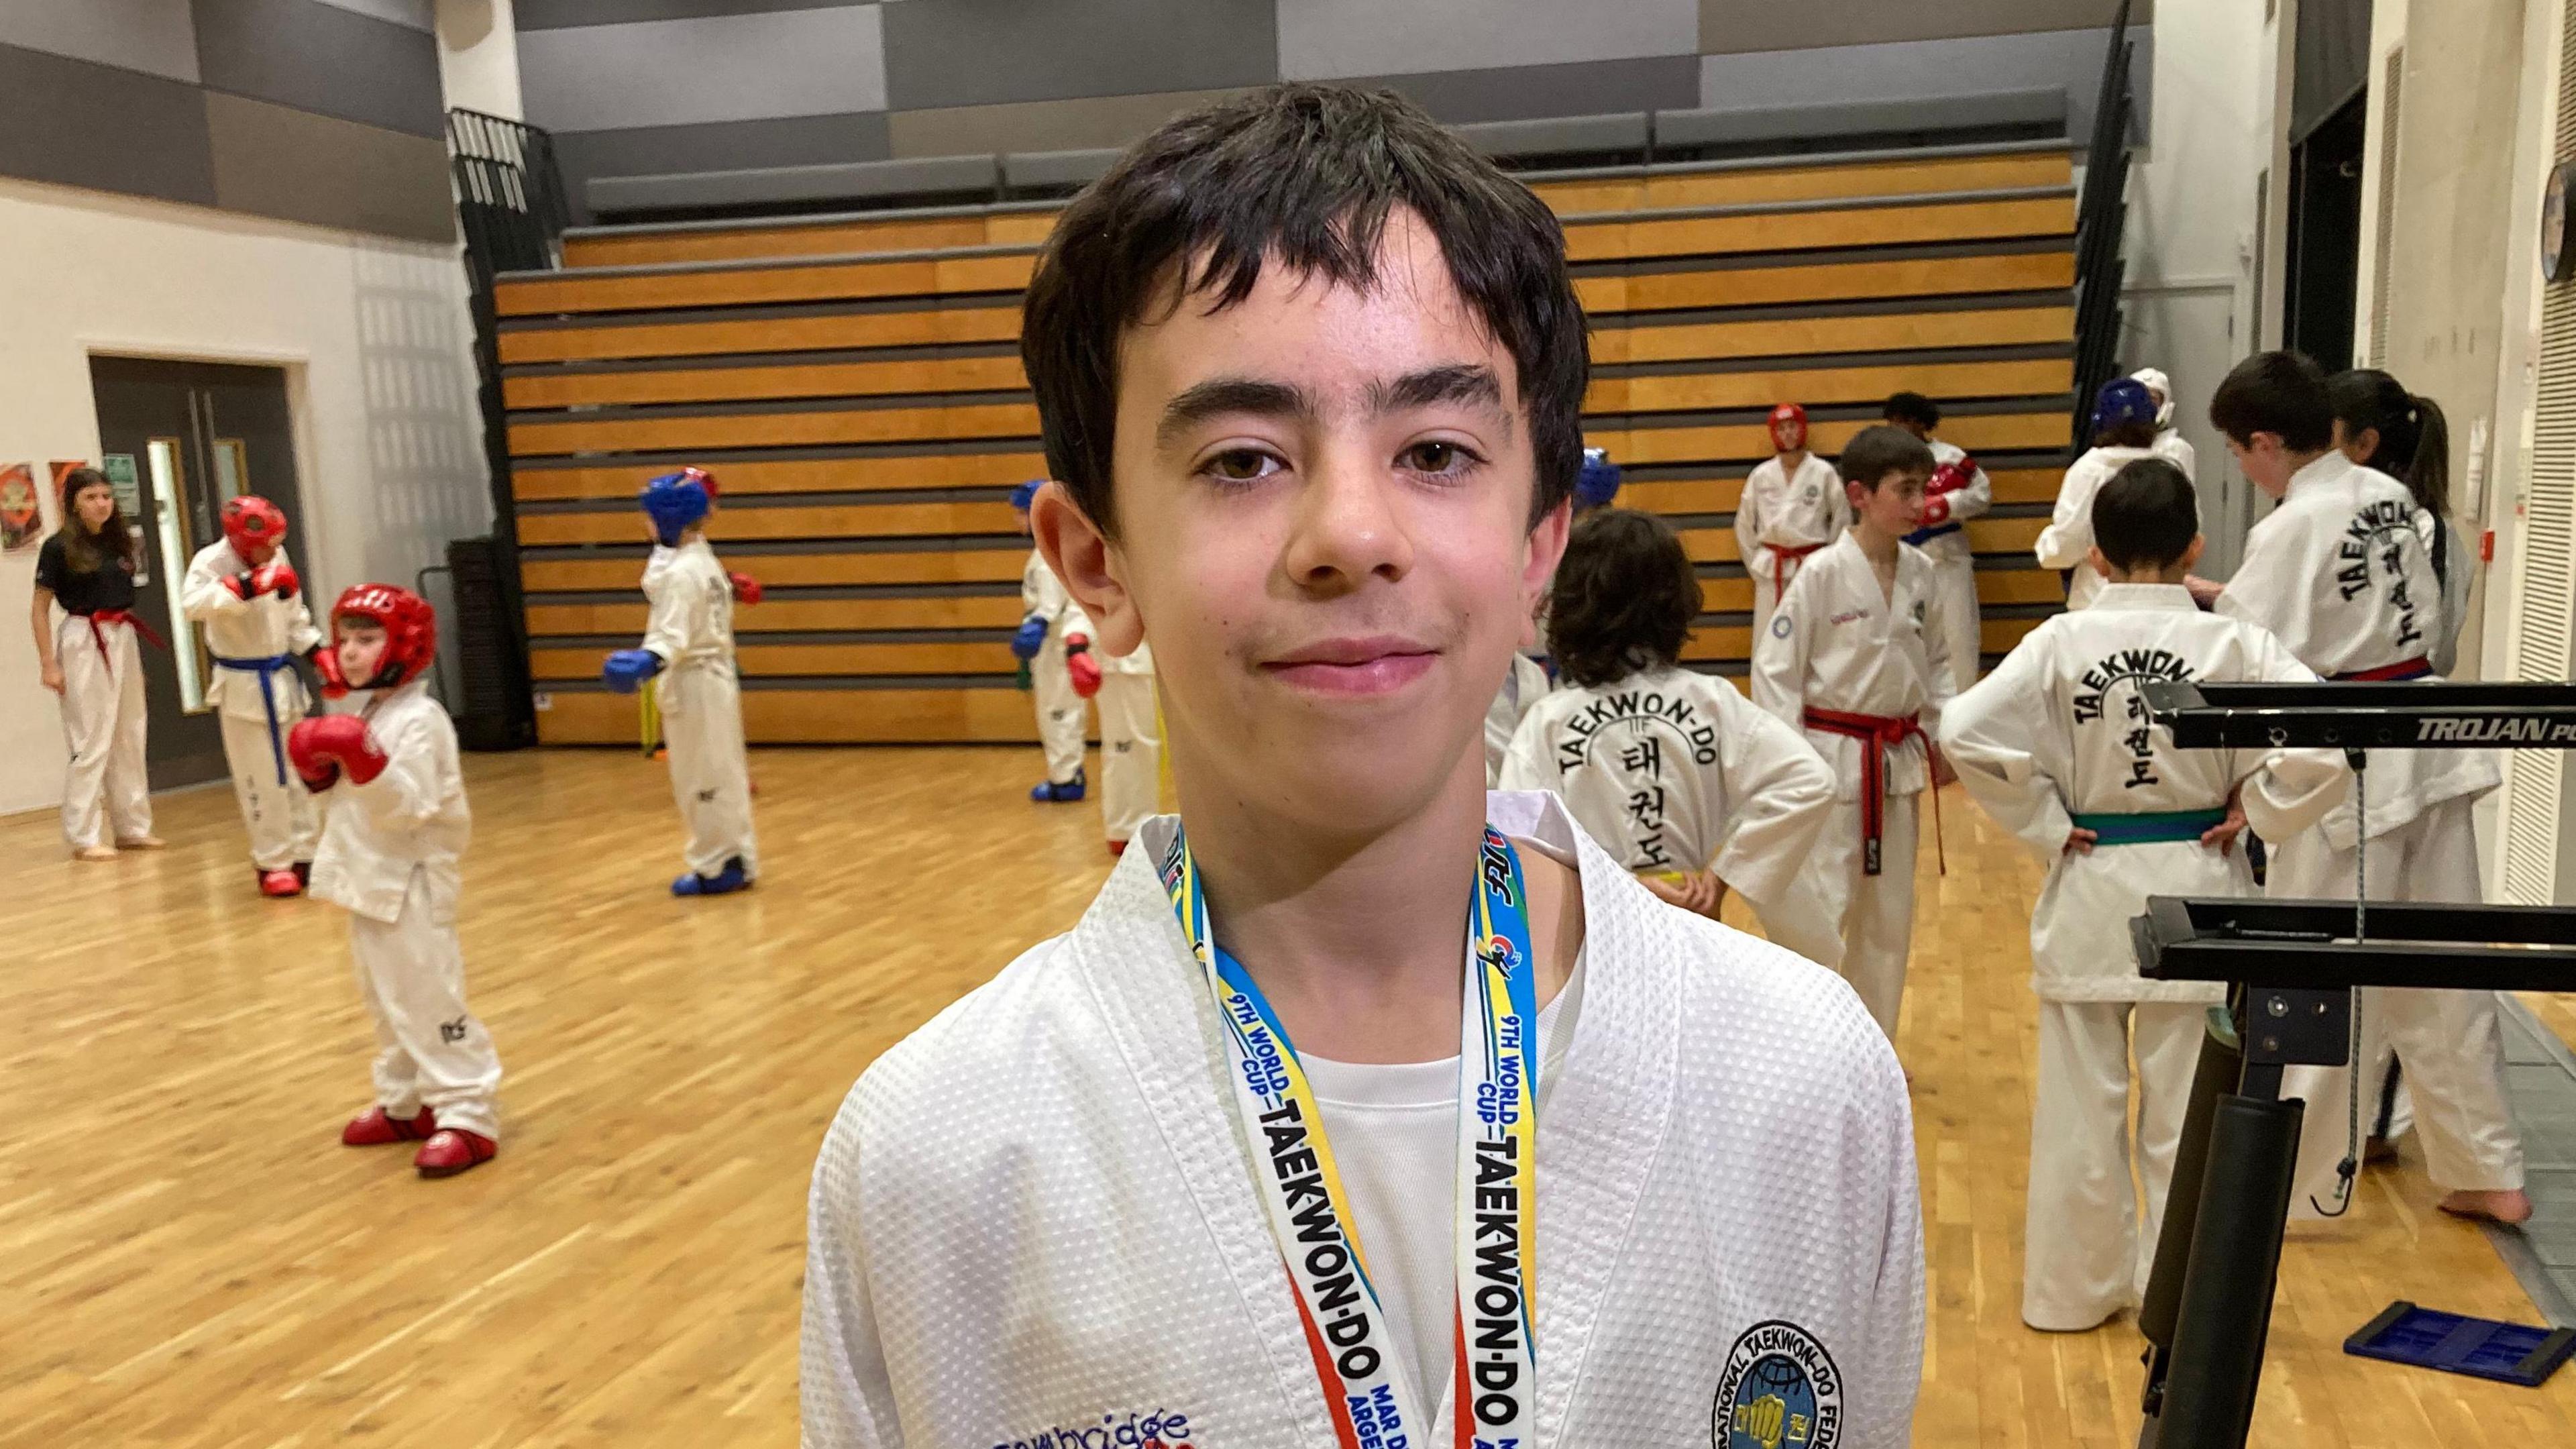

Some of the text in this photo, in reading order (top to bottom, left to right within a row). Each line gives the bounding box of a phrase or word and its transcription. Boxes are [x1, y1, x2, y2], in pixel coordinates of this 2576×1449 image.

[2074, 649, 2195, 724] TAEKWON
[1560, 691, 1716, 775] TAEKWON-DO
[2417, 718, 2550, 741] TROJAN
[1622, 737, 1670, 870] 태권도
[1226, 993, 1289, 1091] 9TH WORLD
[1242, 1060, 1269, 1097] CUP
[1498, 1015, 1519, 1124] 9TH WORLD
[1477, 1083, 1497, 1123] CUP
[1258, 1099, 1381, 1379] TAEKWON-DO
[1474, 1136, 1519, 1426] TAEKWON-DO
[1347, 1397, 1386, 1449] ARGE
[1371, 1384, 1401, 1433] MAR
